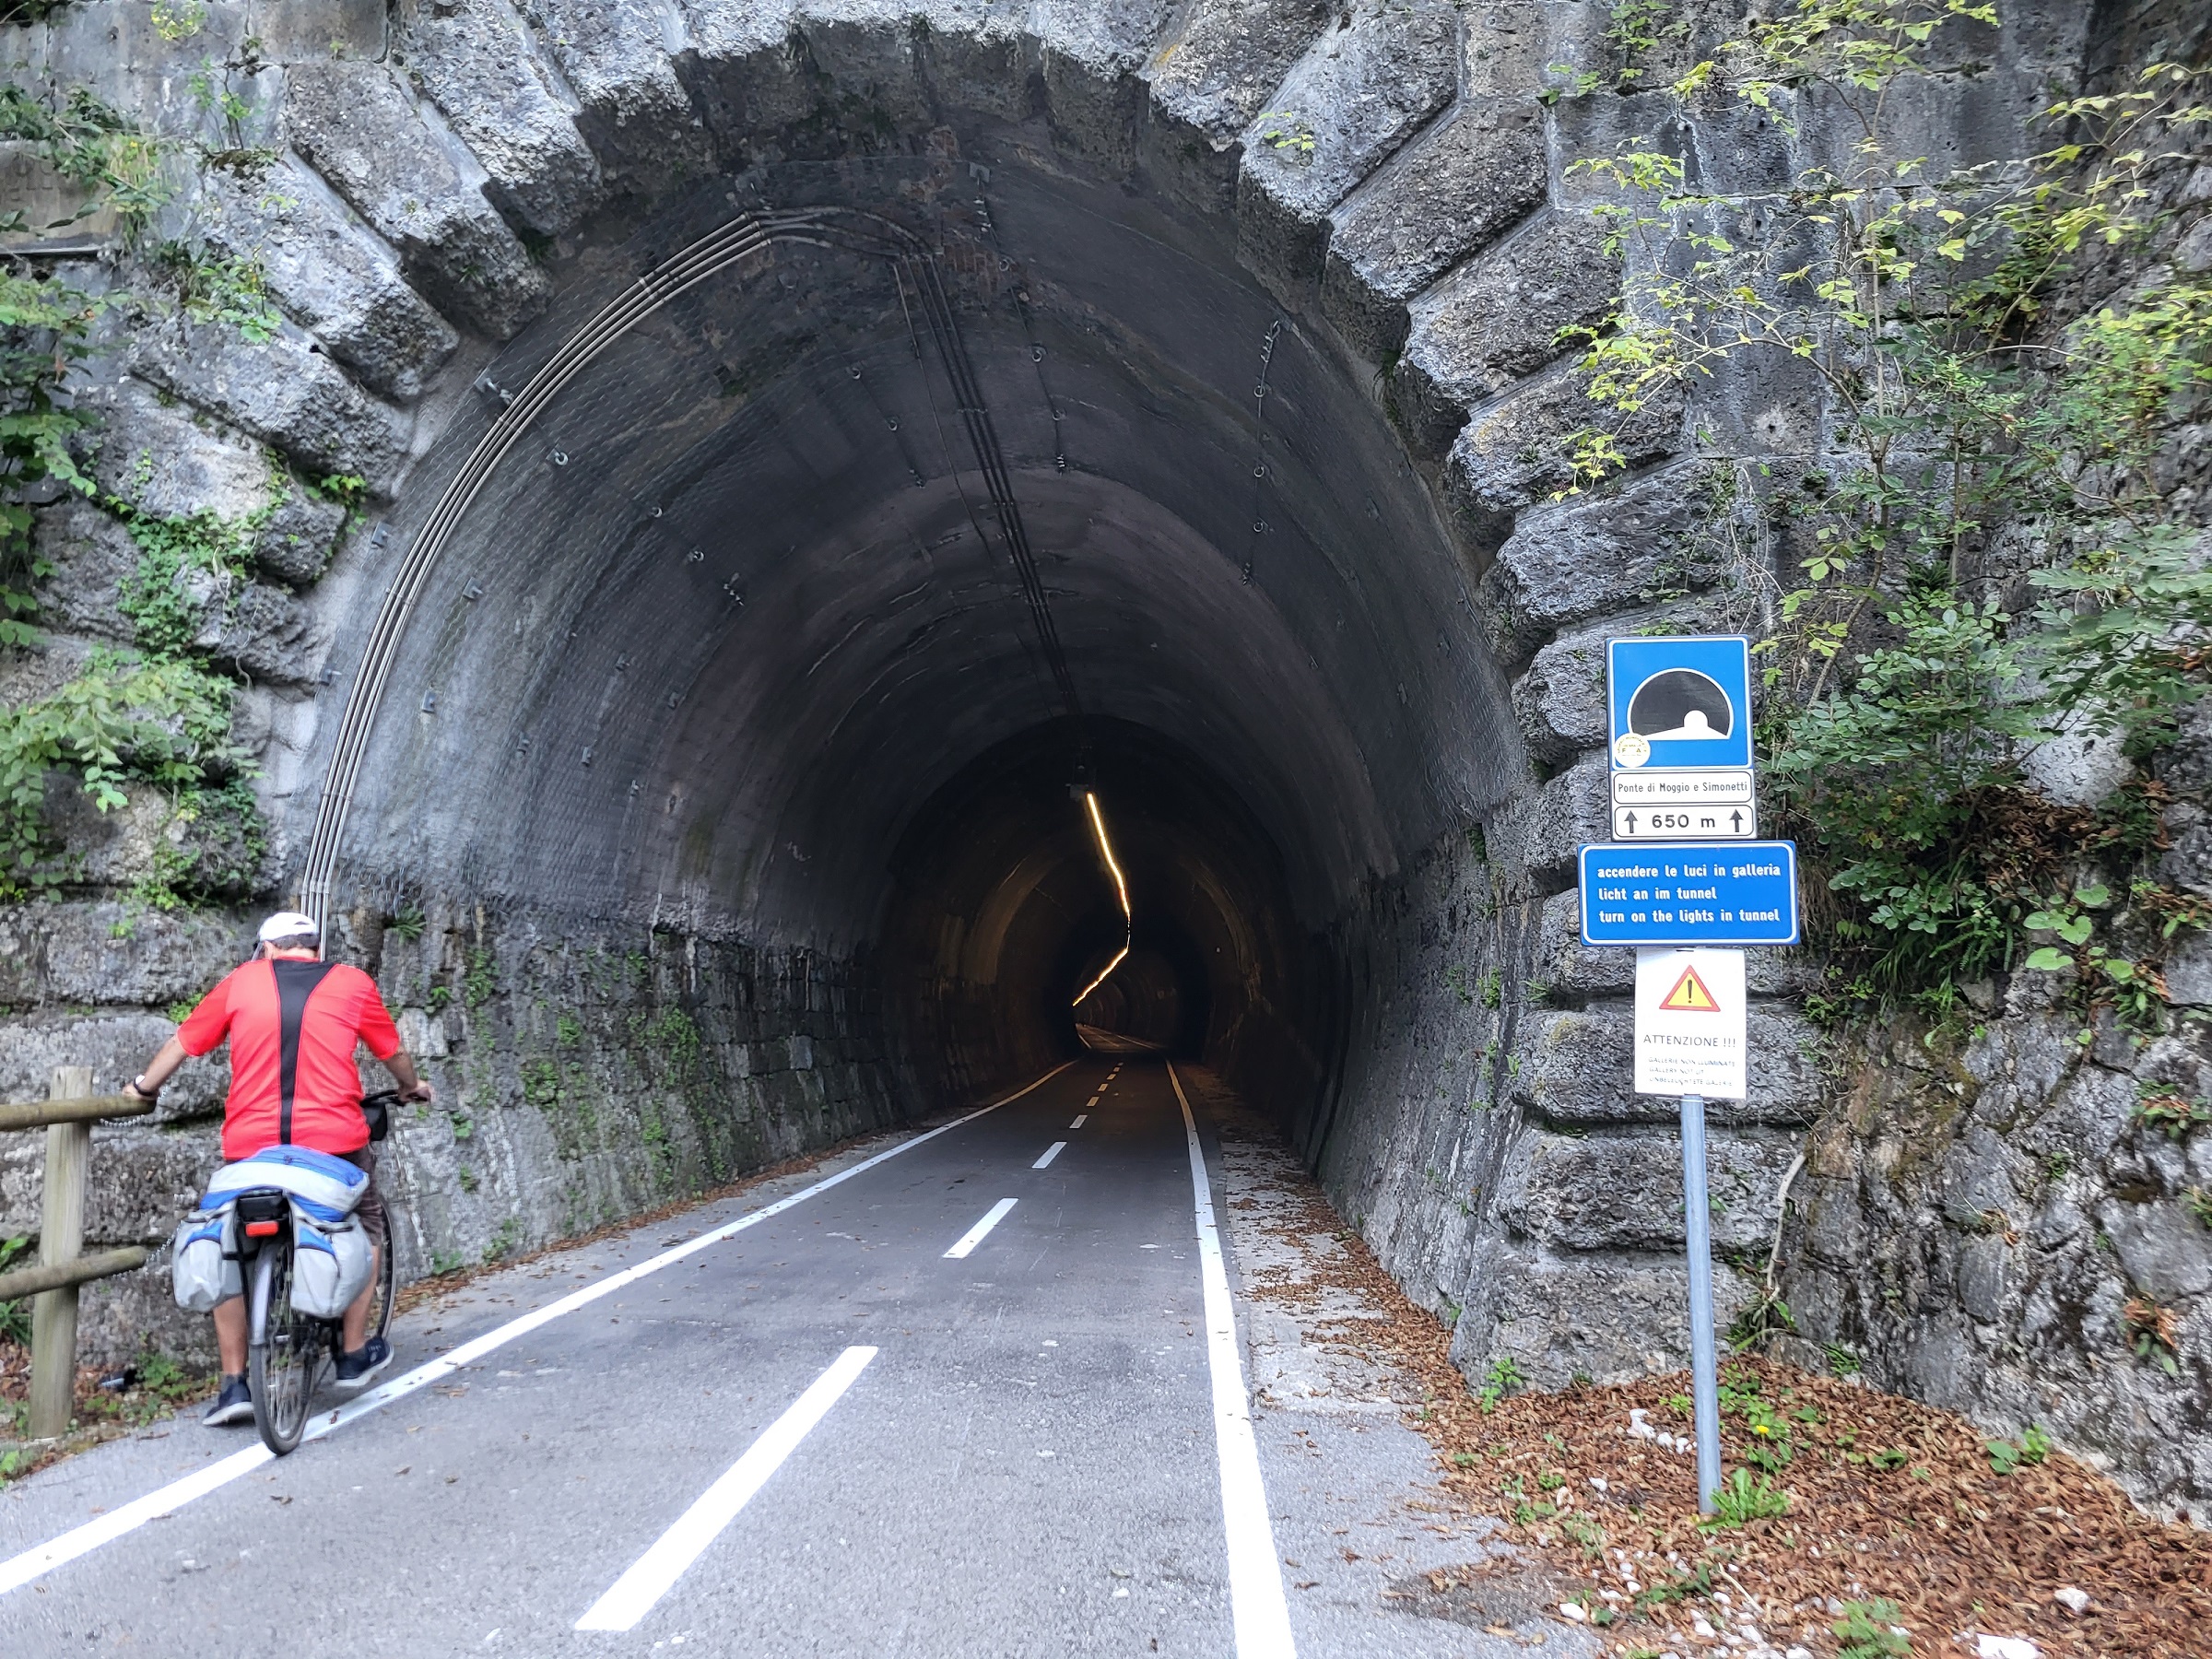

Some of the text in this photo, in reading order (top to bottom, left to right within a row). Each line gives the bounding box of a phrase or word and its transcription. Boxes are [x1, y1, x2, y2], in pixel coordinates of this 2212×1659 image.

[1618, 782, 1644, 793] Ponte
[1647, 782, 1655, 793] di
[1659, 782, 1690, 794] Moggio
[1701, 781, 1747, 792] Simonetti
[1652, 814, 1716, 829] 650 m
[1597, 864, 1781, 878] accendere le luci in galleria
[1599, 887, 1717, 900] licht an im tunnel
[1599, 909, 1780, 924] turn on the lights in tunnel
[1642, 1034, 1735, 1048] ATTENZIONE !!!
